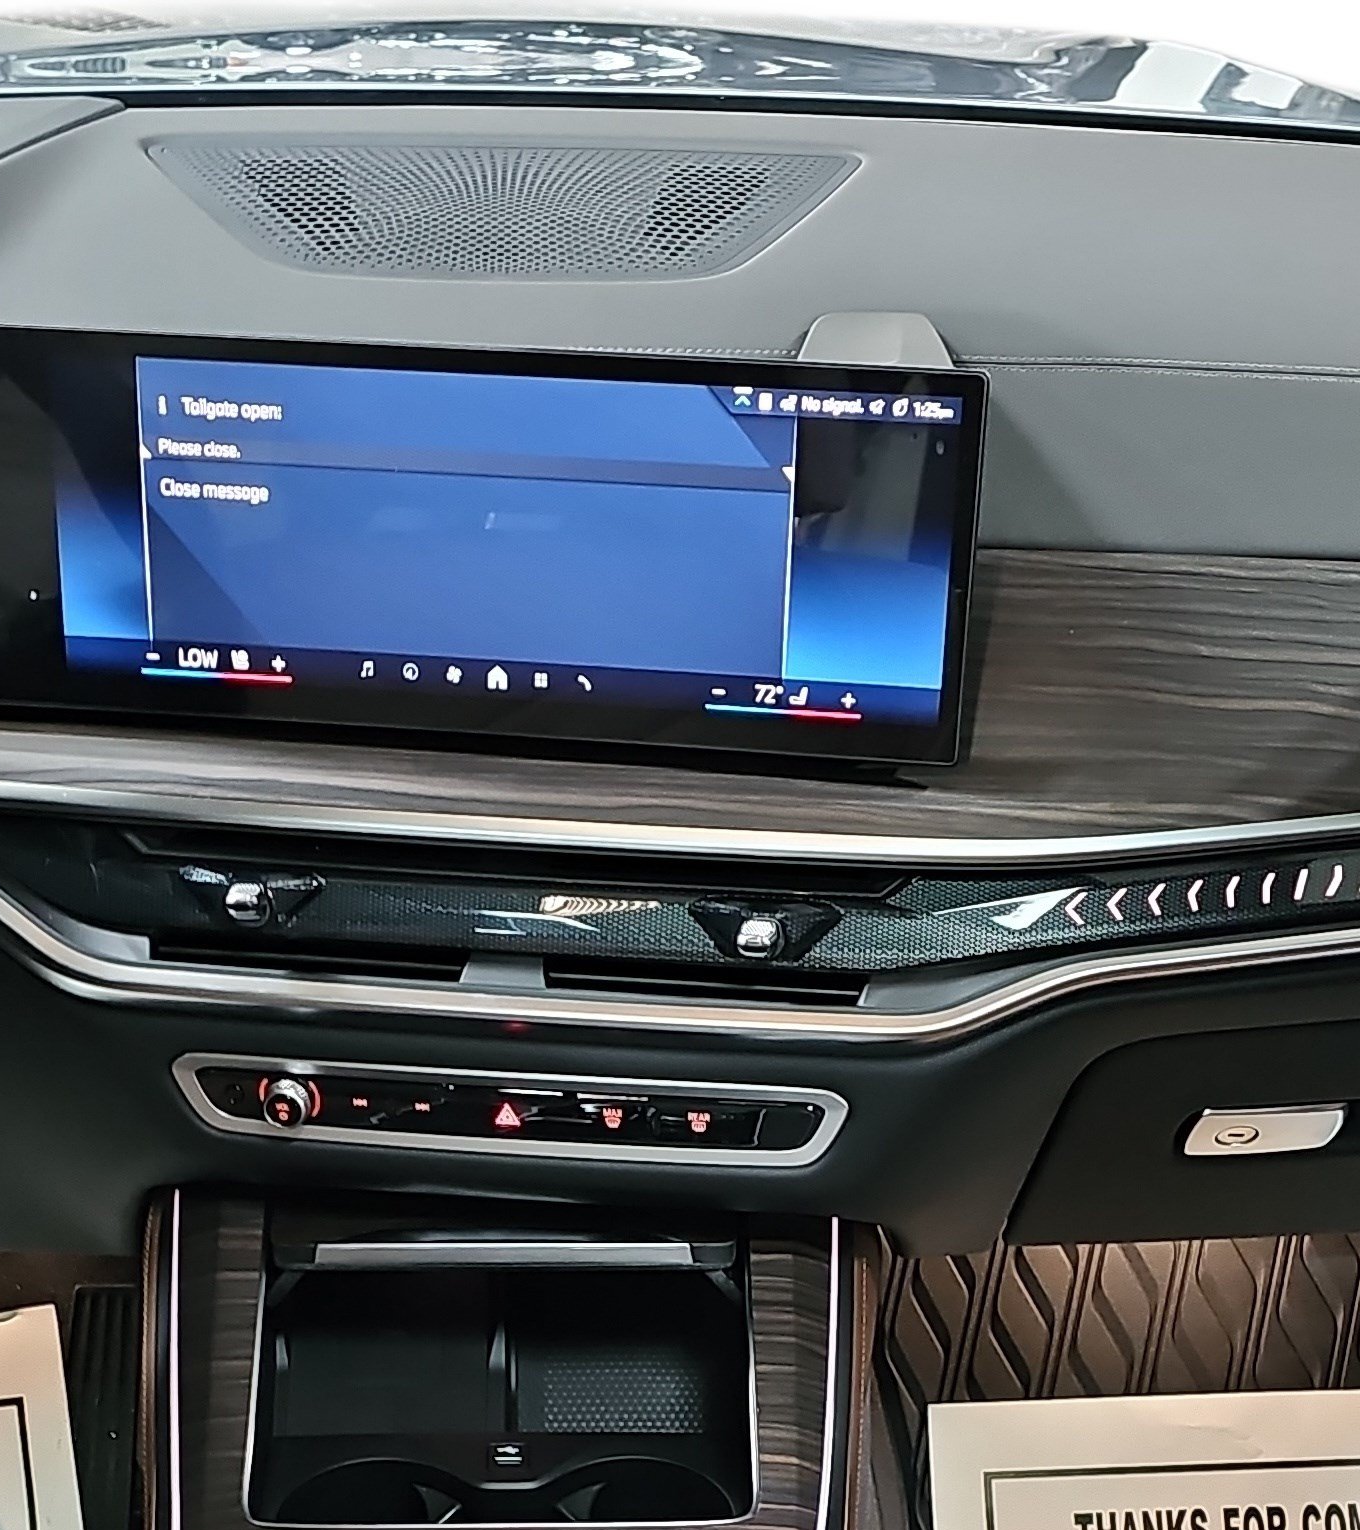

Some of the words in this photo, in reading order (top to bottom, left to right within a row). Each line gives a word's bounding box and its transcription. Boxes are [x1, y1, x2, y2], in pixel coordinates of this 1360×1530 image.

[181, 396, 238, 421] Tailgate
[802, 395, 821, 412] No
[158, 437, 202, 456] Please
[203, 440, 242, 459] close.
[160, 477, 201, 499] Close
[202, 483, 270, 505] message
[178, 647, 219, 669] LOW
